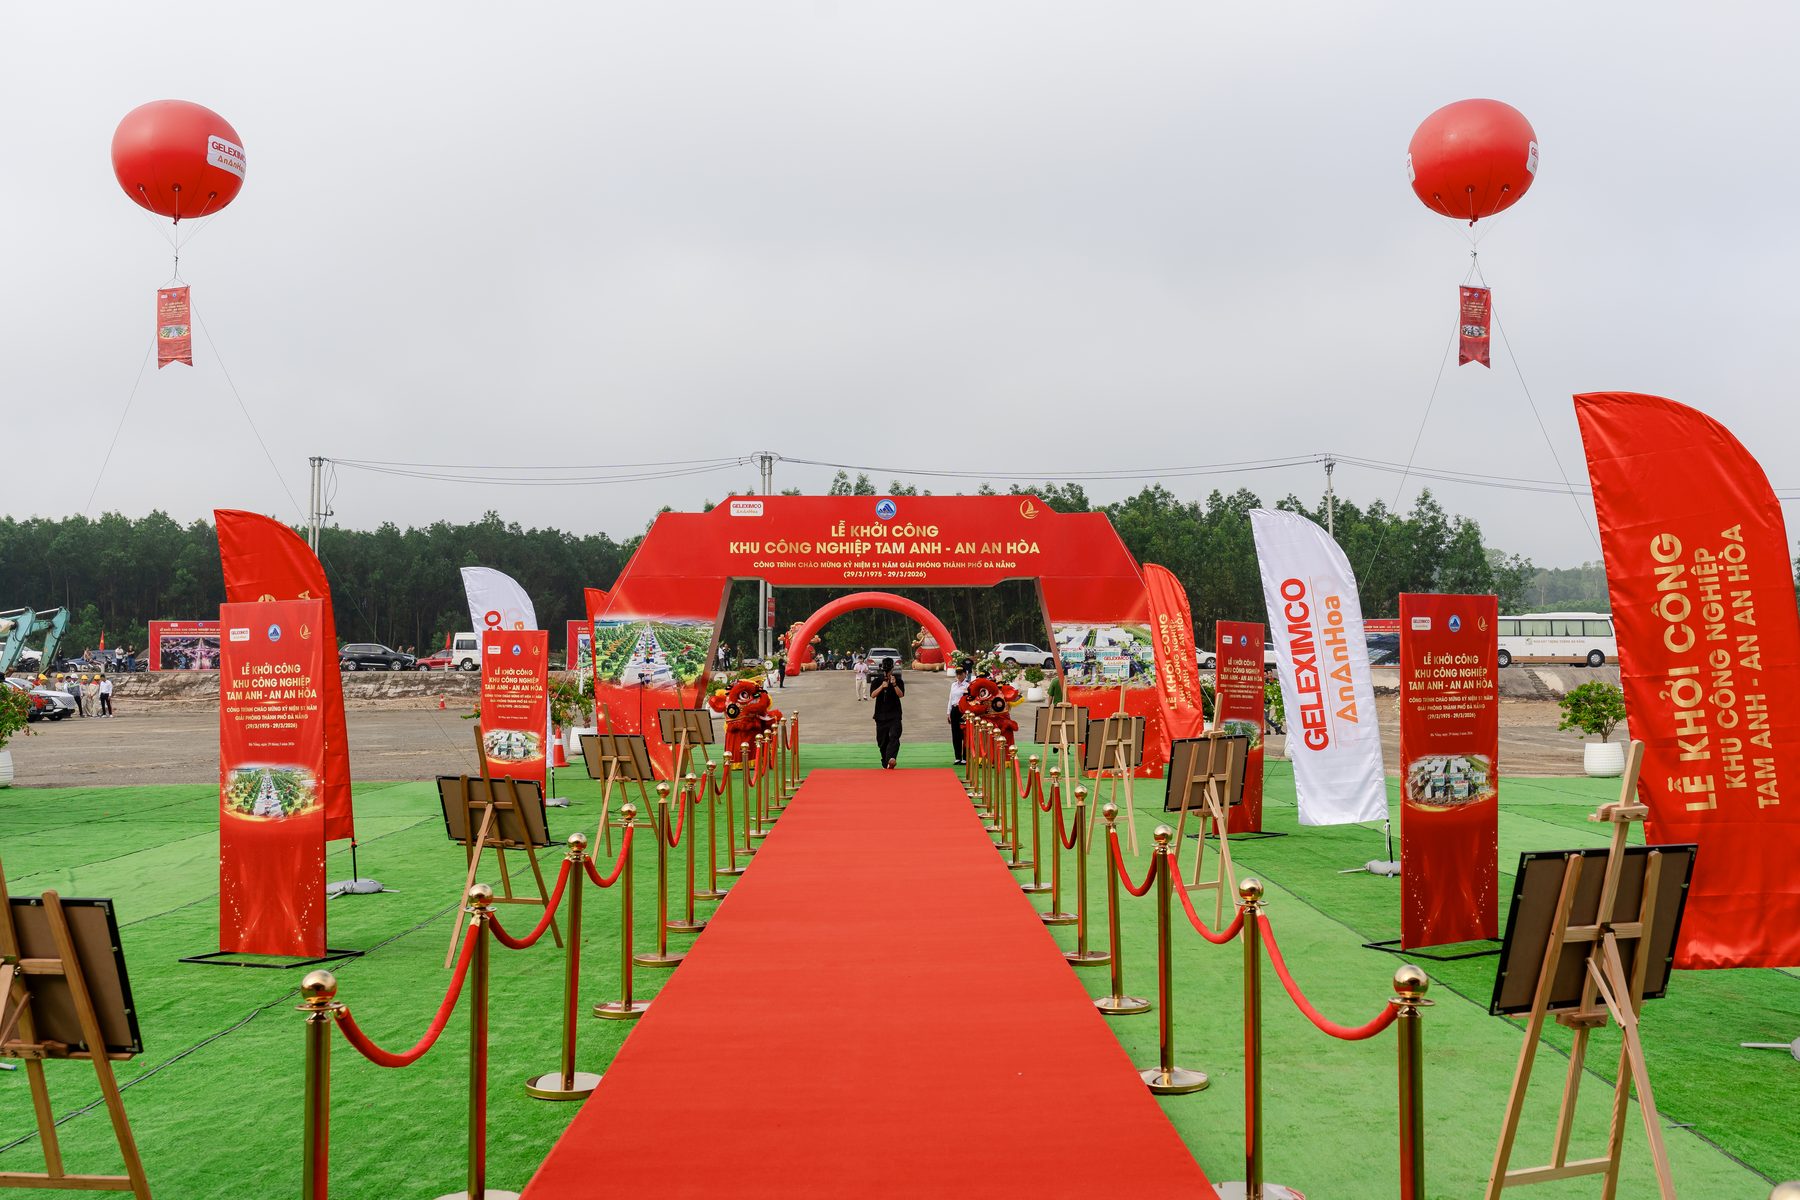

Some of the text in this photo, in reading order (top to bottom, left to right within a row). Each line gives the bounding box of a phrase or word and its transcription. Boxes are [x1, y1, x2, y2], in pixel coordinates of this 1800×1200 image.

[831, 520, 939, 537] LỄ KHỞI CÔNG
[729, 542, 760, 554] KHU
[764, 539, 812, 554] CÔNG
[816, 539, 871, 557] NGHIỆP
[875, 542, 904, 554] TAM
[909, 542, 942, 554] ANH
[954, 542, 976, 554] AN
[980, 542, 1002, 554] AN
[1007, 539, 1040, 554] HÒA
[1718, 523, 1750, 581] HÒA
[854, 561, 870, 569] NIỆM
[967, 560, 982, 568] PHỐ
[1730, 590, 1758, 626] AN
[1178, 633, 1185, 646] AN
[1323, 595, 1359, 723] AnAnHoa
[1424, 652, 1479, 665] LỄ KHỞI CÔNG
[1736, 634, 1762, 671] AN
[242, 662, 301, 675] LỄ KHỞI CÔNG
[1280, 578, 1329, 751] GELEXIMCO
[1415, 666, 1487, 679] KHU CÔNG NGHIỆP
[1650, 533, 1717, 812] LỄ KHỞI CÔNG
[1691, 547, 1747, 789] KHU CÔNG NGHIỆP
[233, 675, 311, 688] KHU CÔNG NGHIỆP
[1409, 681, 1425, 690] TAM
[1427, 681, 1444, 690] ANH
[1450, 680, 1461, 689] AN
[1463, 680, 1474, 689] AN
[1476, 677, 1493, 689] HÒA
[226, 691, 242, 700] TAM
[245, 691, 262, 700] ANH
[269, 690, 281, 699] AN
[283, 690, 296, 699] AN
[298, 687, 317, 699] HÒA
[1745, 694, 1772, 749] ANH
[1753, 757, 1780, 809] TAM
